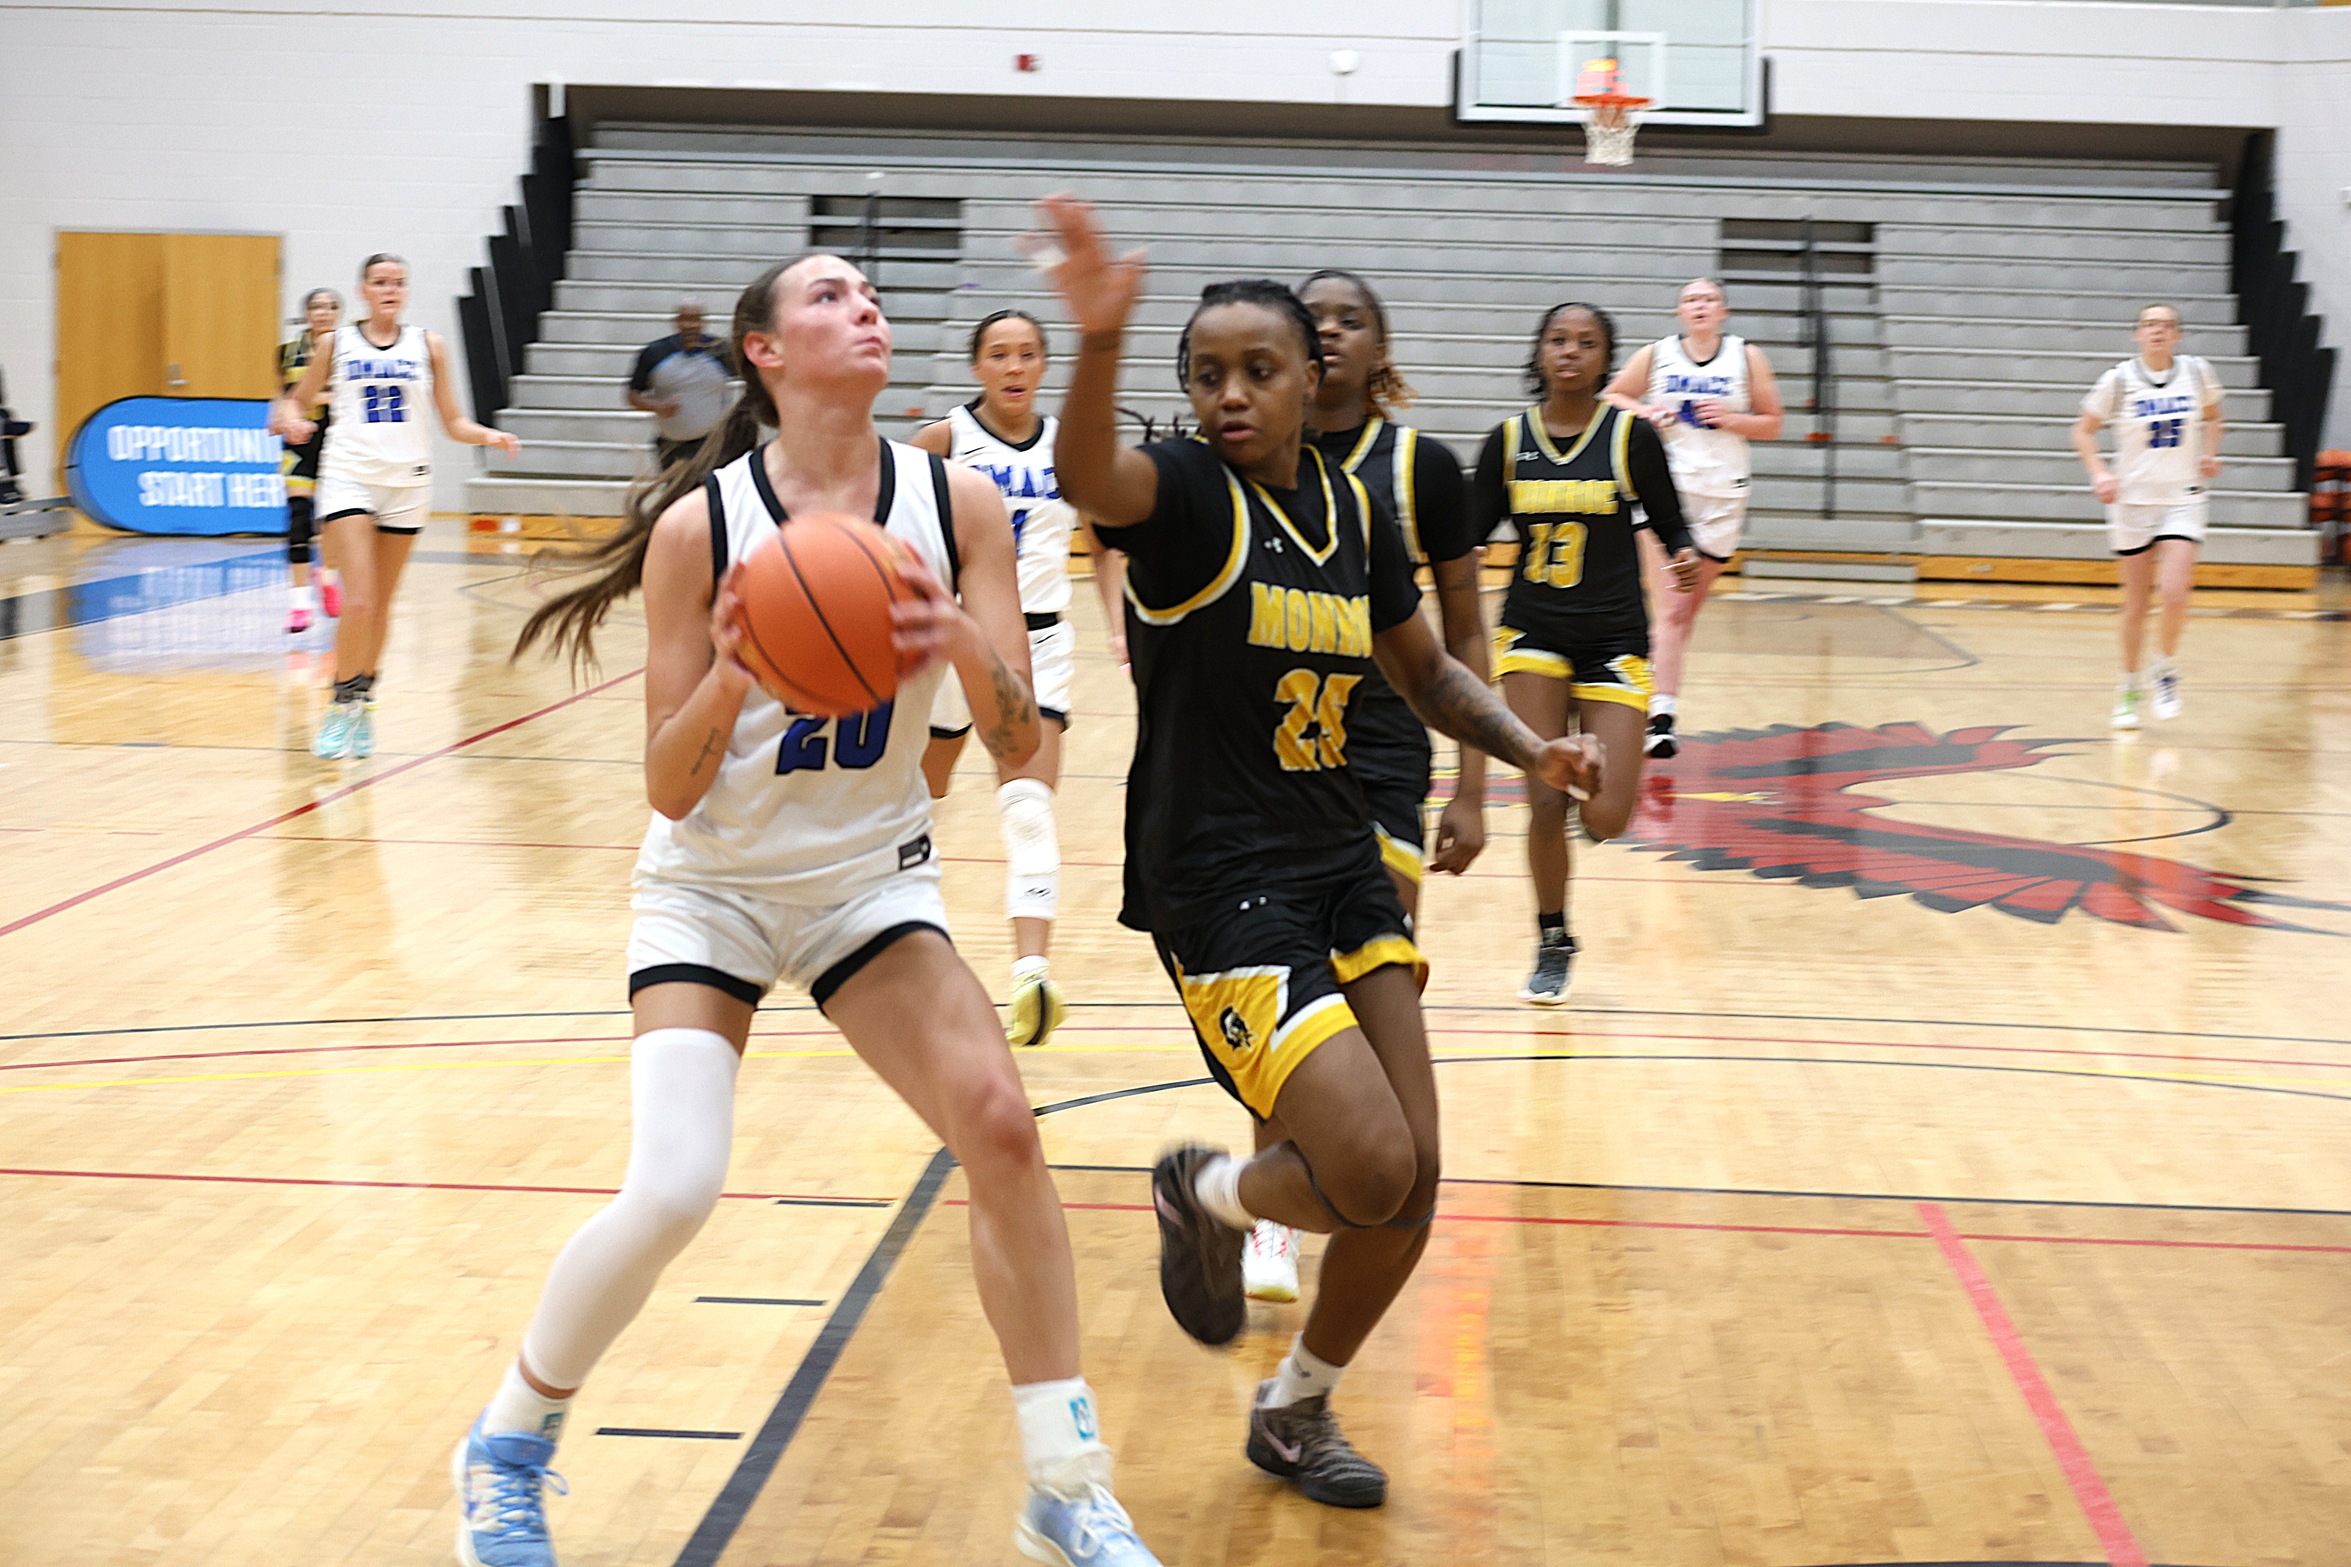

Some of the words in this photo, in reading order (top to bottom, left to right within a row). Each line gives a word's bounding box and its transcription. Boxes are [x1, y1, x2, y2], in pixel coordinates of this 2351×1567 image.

[362, 385, 409, 424] 22
[138, 471, 225, 507] START
[1523, 521, 1589, 589] 13
[775, 696, 895, 775] 20
